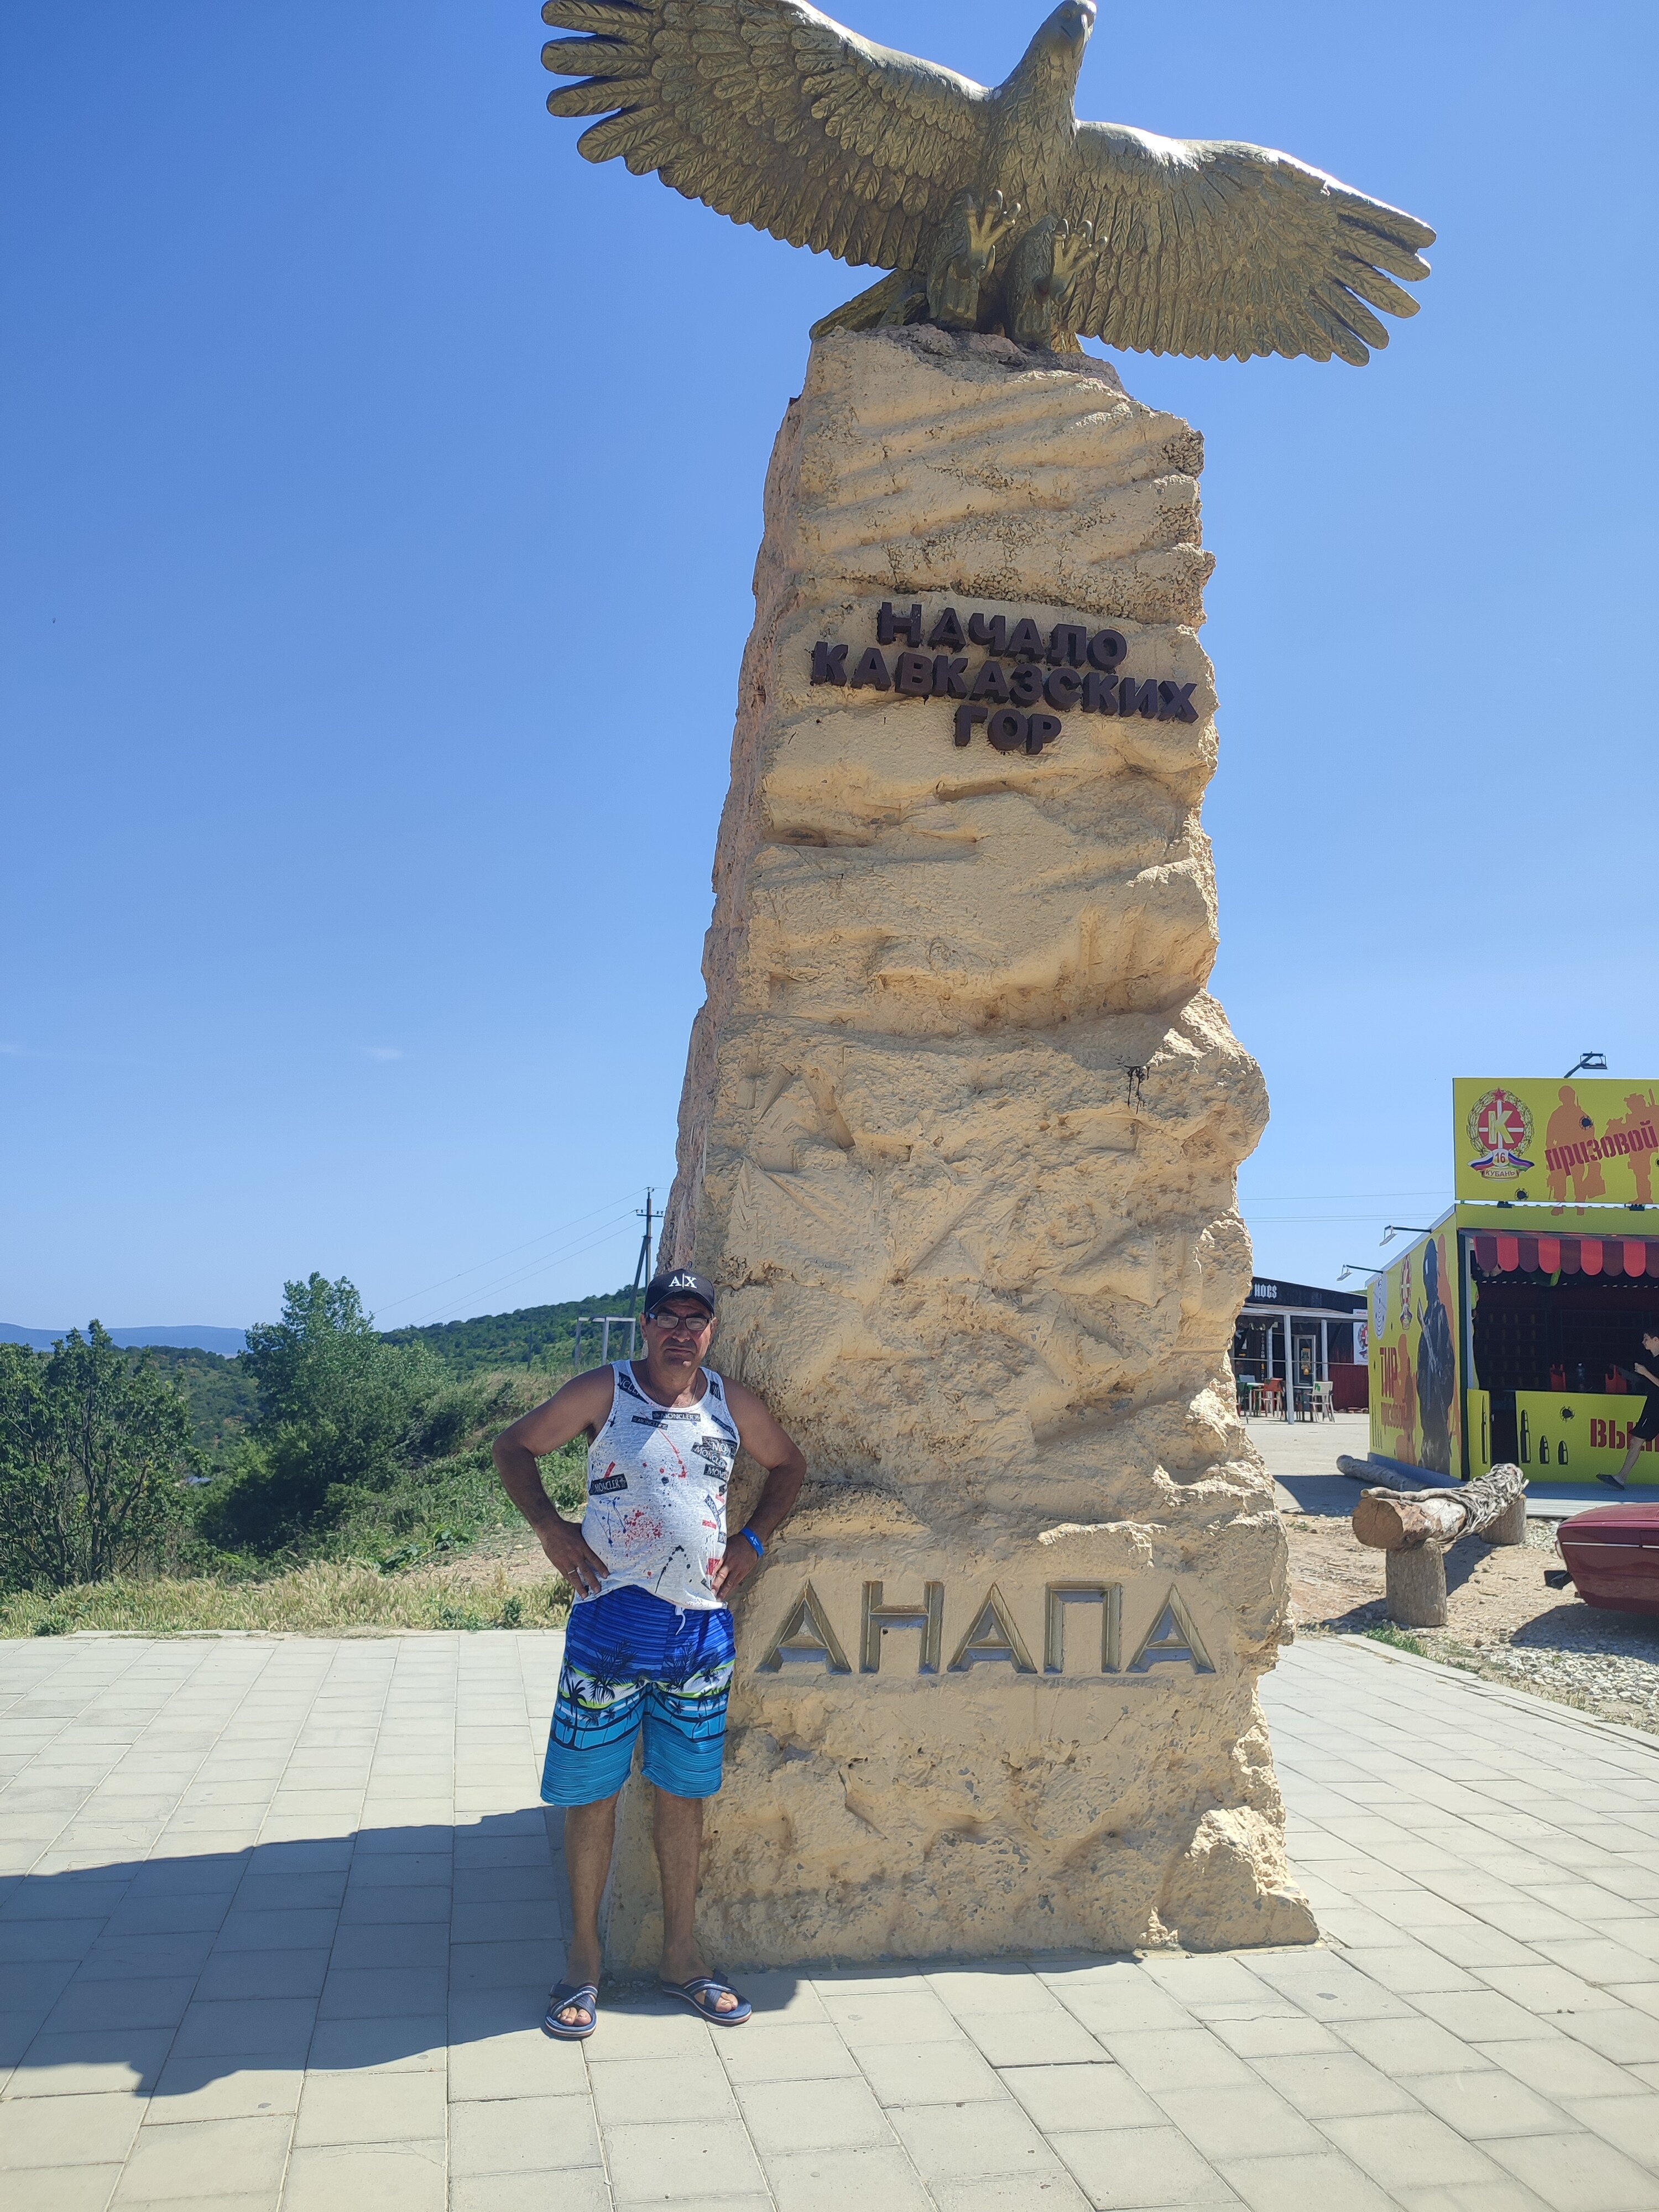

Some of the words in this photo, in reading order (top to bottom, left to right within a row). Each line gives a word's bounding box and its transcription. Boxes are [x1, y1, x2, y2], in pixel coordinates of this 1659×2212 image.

[877, 601, 1128, 673] НАЧАЛО
[810, 641, 1199, 723] КАВКАЗСКИХ
[954, 705, 1062, 754] ГОР
[1495, 1152, 1506, 1164] 16
[594, 1479, 620, 1493] MONCLER
[755, 1579, 1216, 1675] АНАПА
